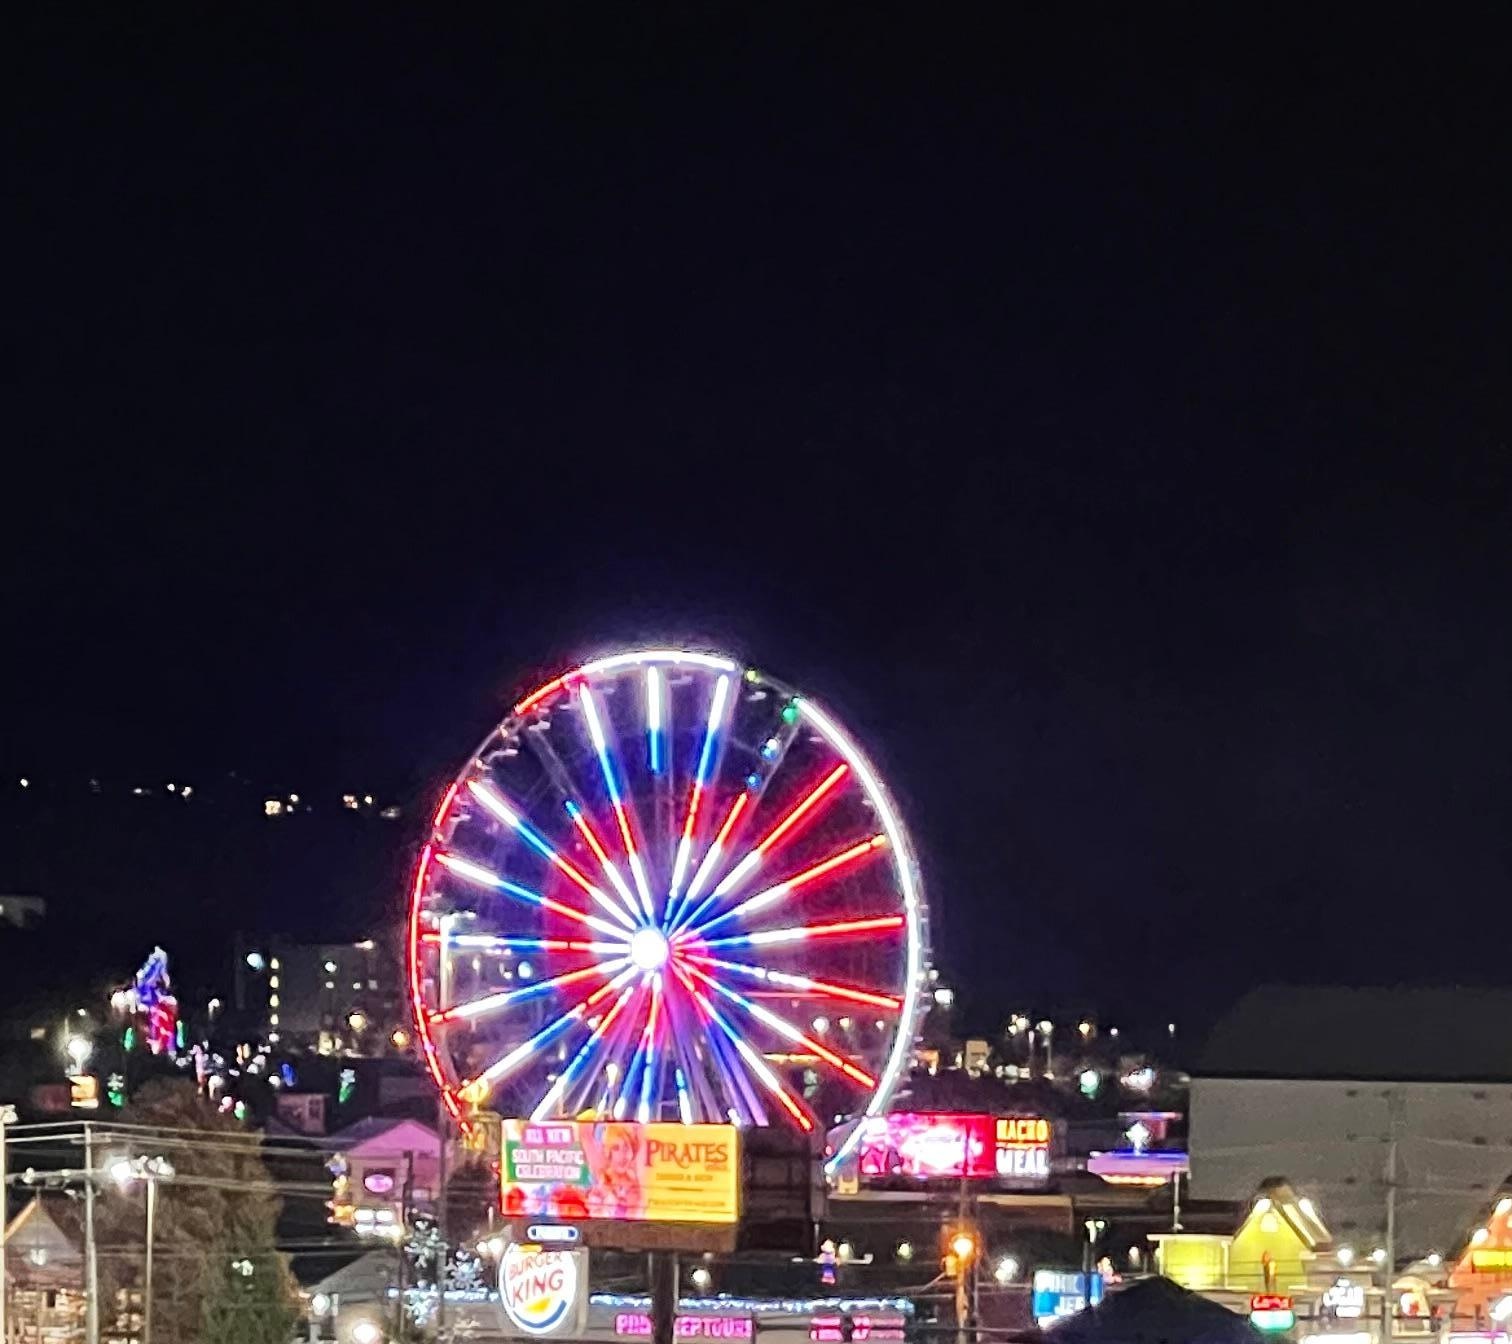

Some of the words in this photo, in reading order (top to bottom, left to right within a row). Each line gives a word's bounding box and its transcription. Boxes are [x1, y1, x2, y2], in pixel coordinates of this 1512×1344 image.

[645, 1139, 729, 1168] PIRATES
[996, 1148, 1049, 1174] MEAL
[508, 1253, 563, 1278] BURGER
[512, 1269, 564, 1304] KING
